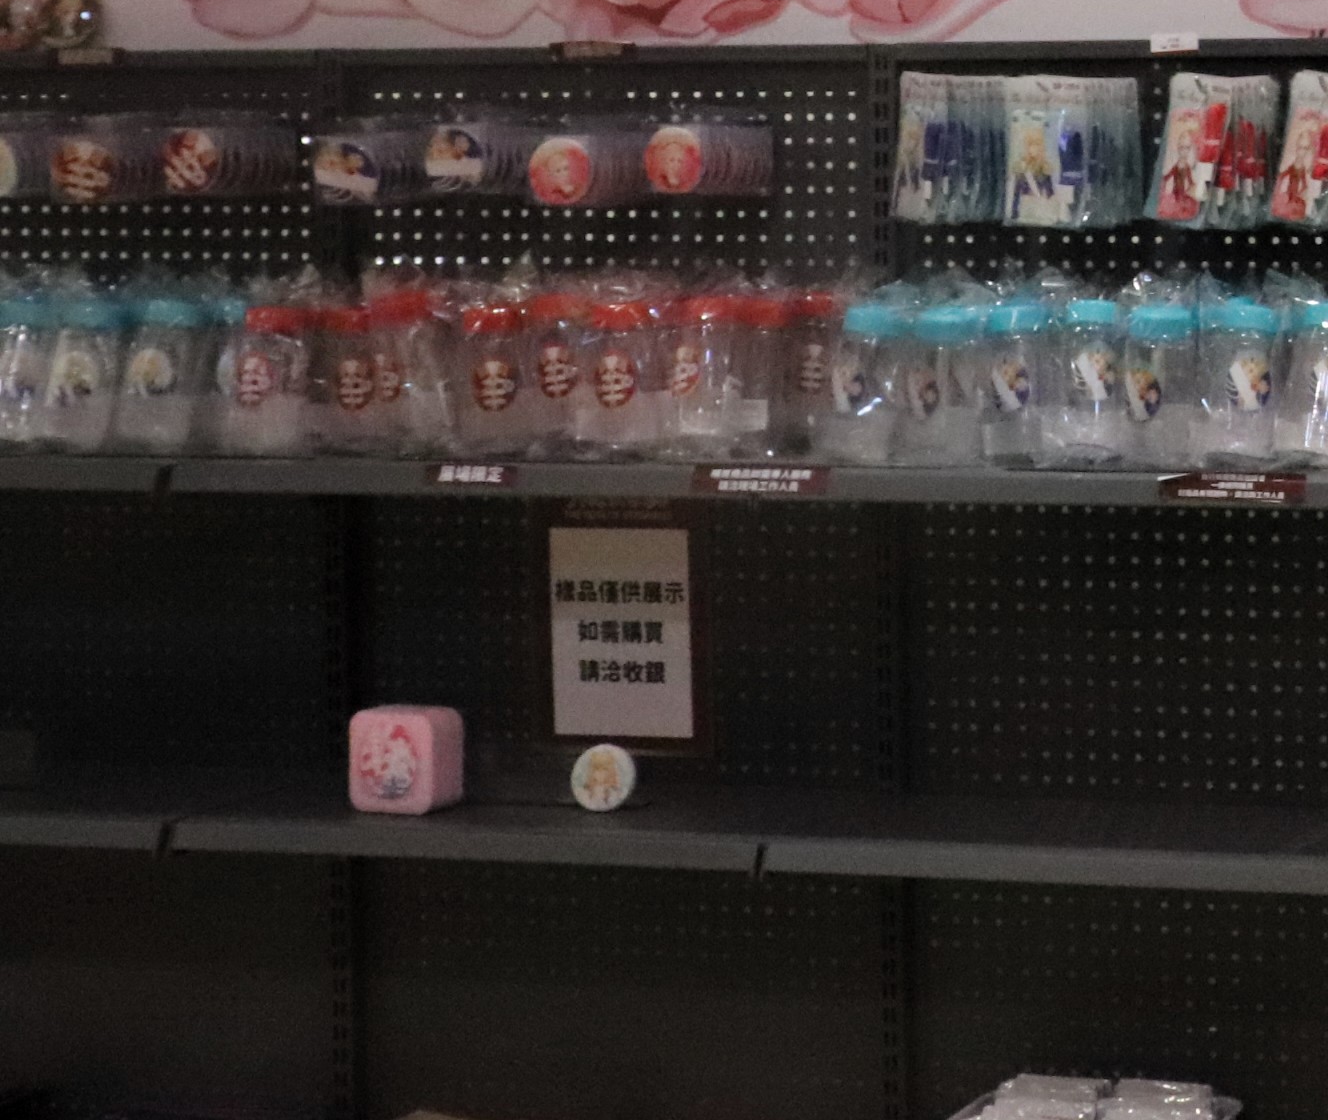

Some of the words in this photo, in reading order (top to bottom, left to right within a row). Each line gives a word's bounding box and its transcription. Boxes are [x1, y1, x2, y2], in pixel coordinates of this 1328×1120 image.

[555, 579, 684, 604] 樣品僅供展示
[578, 619, 663, 644] 如需購買
[579, 659, 665, 684] 請洽收銀
